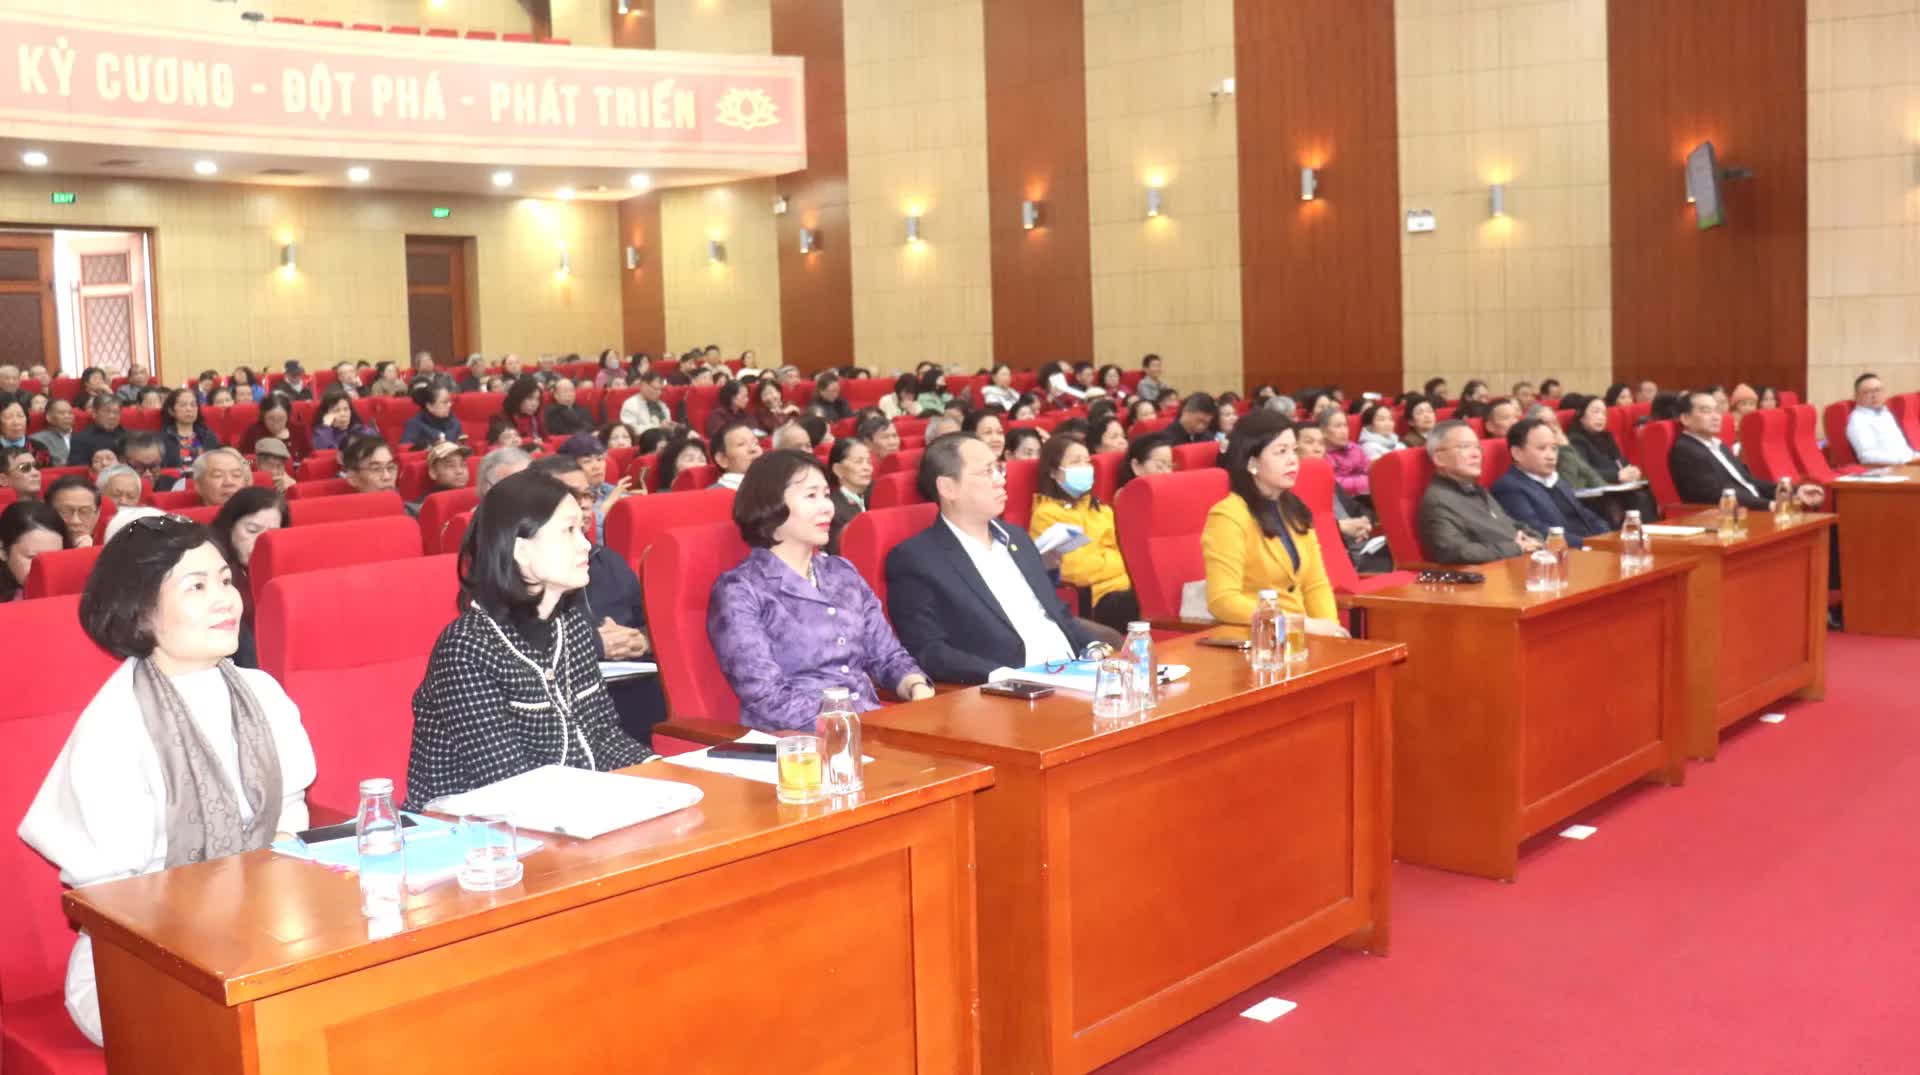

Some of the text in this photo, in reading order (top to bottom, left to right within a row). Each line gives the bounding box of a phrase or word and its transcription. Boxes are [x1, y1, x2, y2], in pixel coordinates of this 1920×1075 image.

[17, 36, 76, 97] KỶ
[95, 51, 234, 108] CƯƠNG
[250, 83, 267, 94] -
[282, 62, 356, 121] ĐỘT
[371, 70, 447, 121] PHÁ
[460, 95, 475, 105] -
[489, 76, 580, 128] PHÁT
